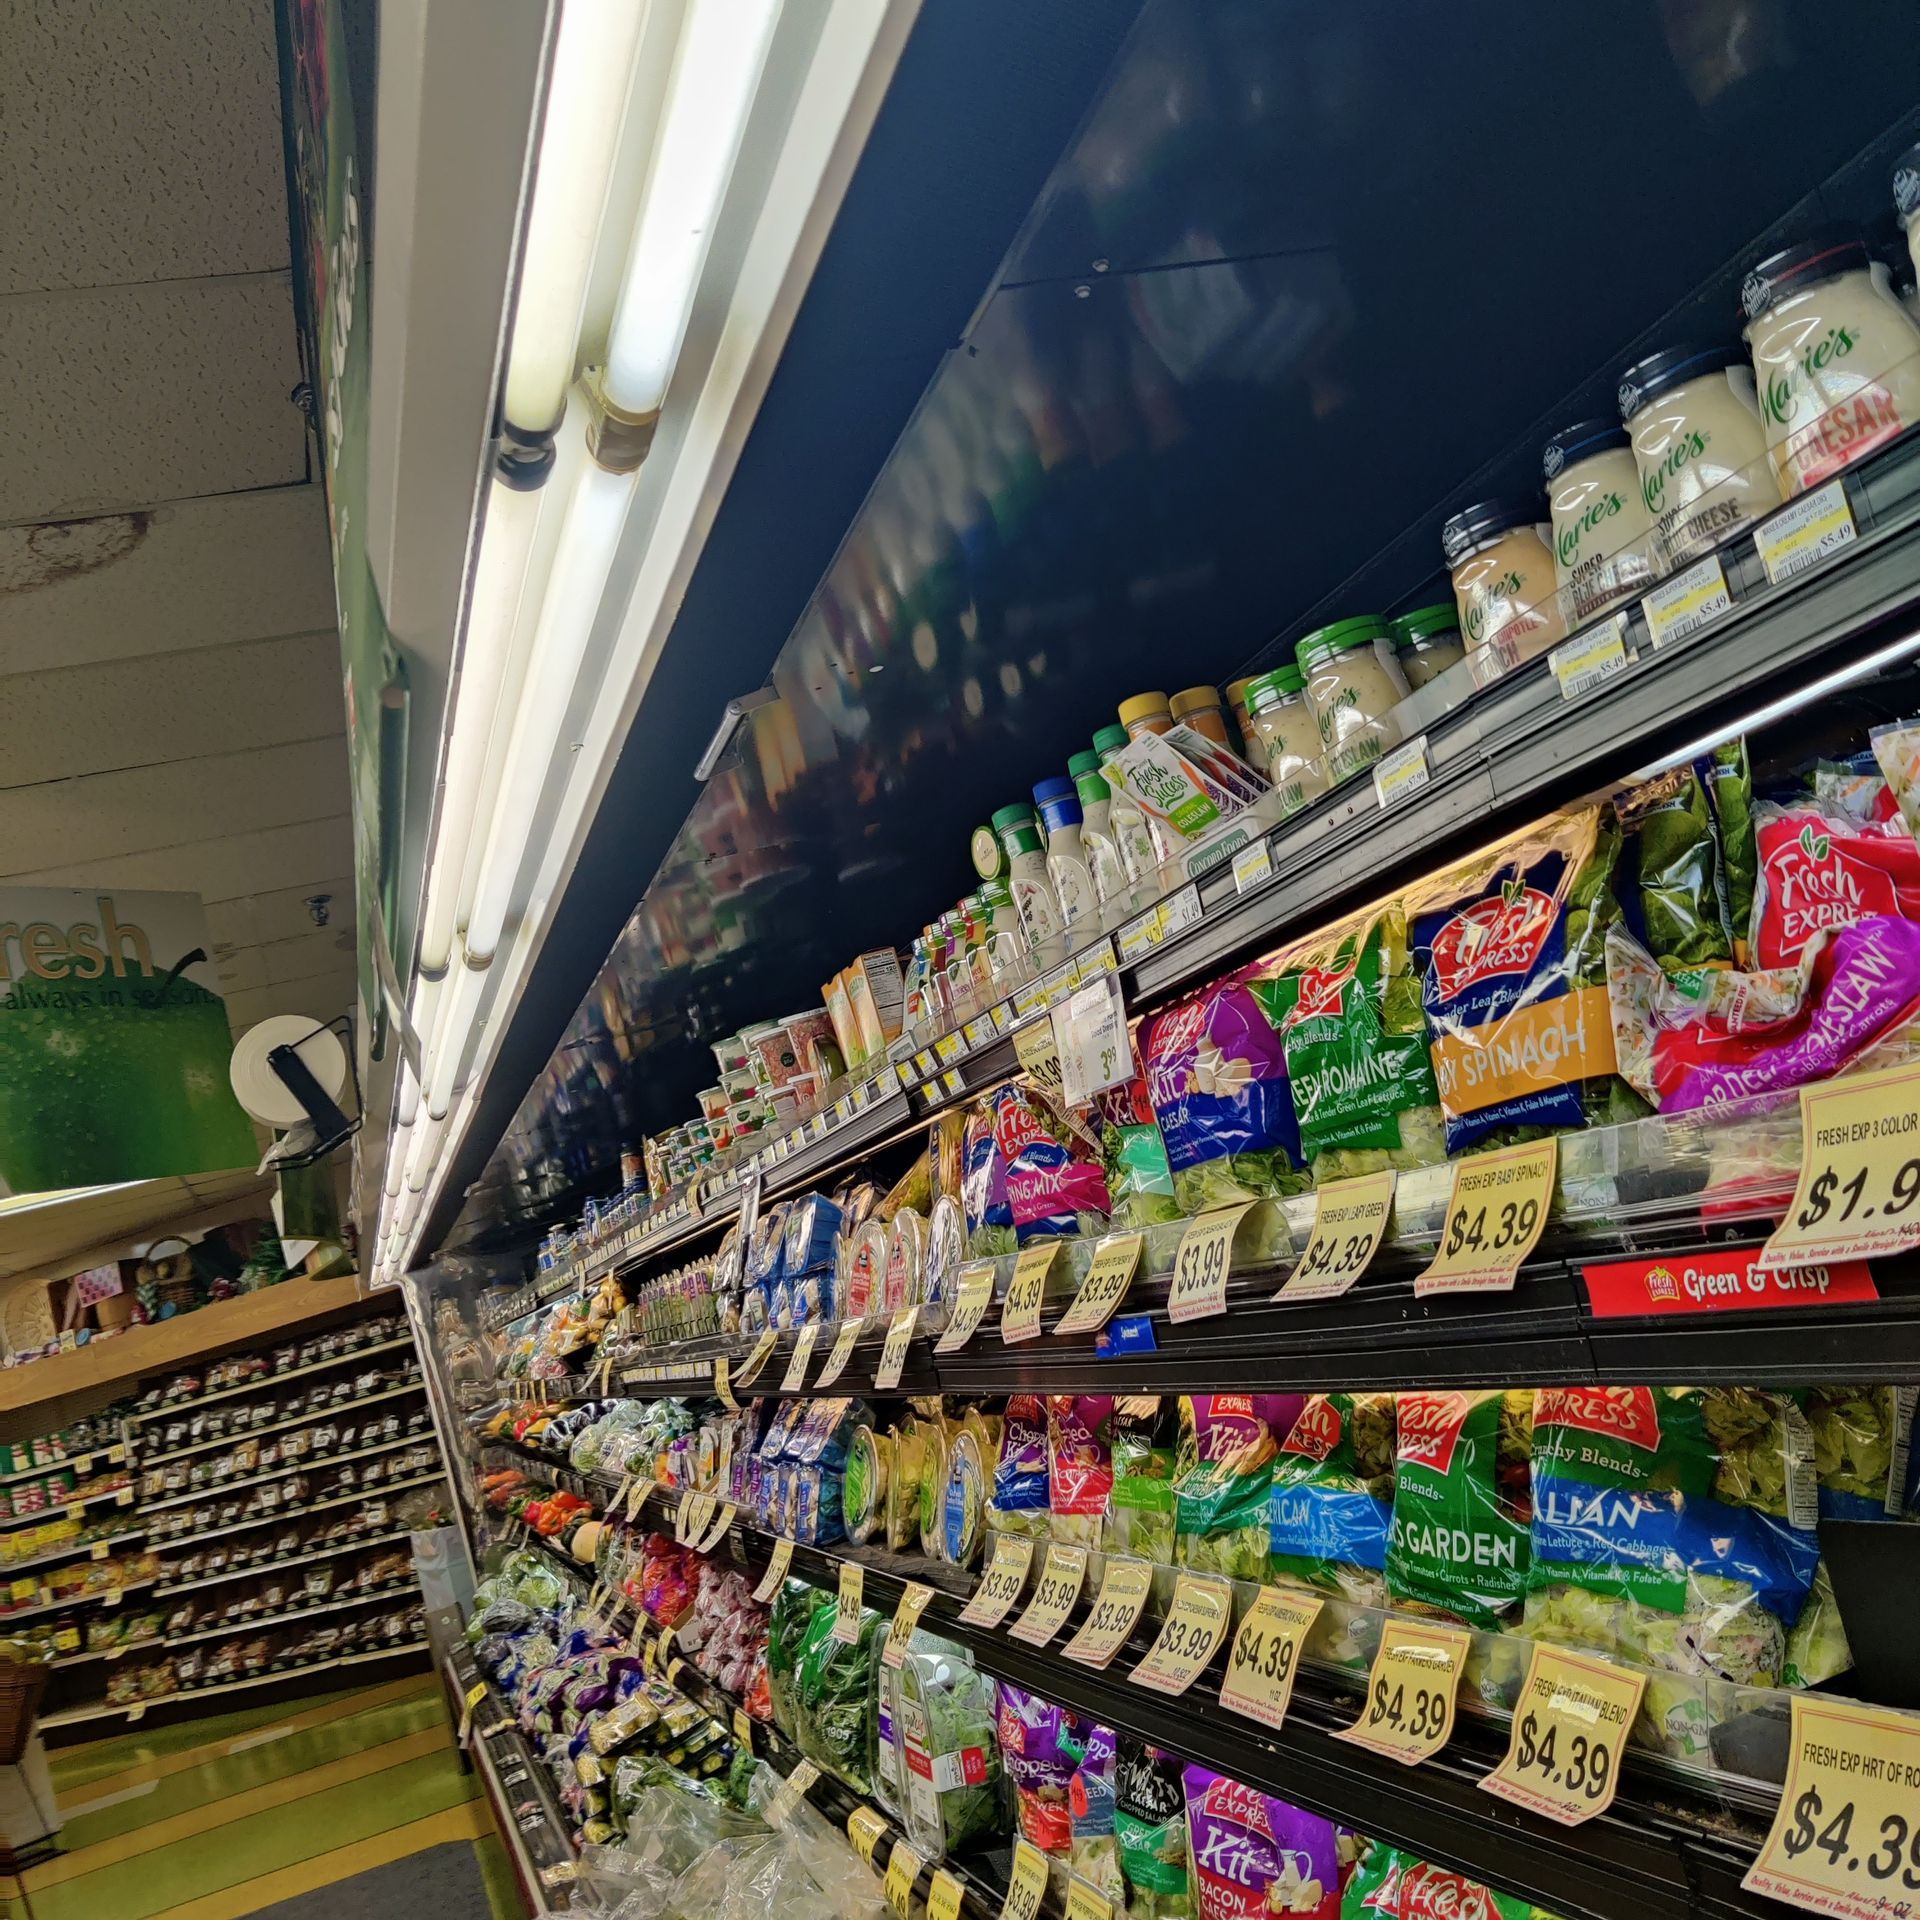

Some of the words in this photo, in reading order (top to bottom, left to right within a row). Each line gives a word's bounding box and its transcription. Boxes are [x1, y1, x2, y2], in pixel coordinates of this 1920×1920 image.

[1757, 325, 1856, 429] Marie's
[1687, 498, 1742, 540] CHEESE
[1820, 524, 1851, 549] $5.49
[1700, 595, 1727, 618] $5.49
[1600, 655, 1624, 676] $5.49
[1127, 759, 1169, 797] Fresh
[1145, 774, 1188, 810] Success
[1178, 804, 1213, 829] COLESLAW
[1774, 852, 1864, 910] Fresh
[0, 896, 155, 980] resh
[1783, 901, 1877, 940] EXPRE
[1453, 942, 1534, 988] EXPRESS
[4, 982, 92, 1011] always
[100, 983, 125, 1008] in
[1471, 993, 1498, 1011] Leaf
[1848, 997, 1898, 1038] Carrots
[1462, 1016, 1586, 1088] SPINACH
[1321, 1049, 1400, 1099] ROMAINE
[998, 1103, 1037, 1140] Fre
[1160, 1106, 1190, 1133] CAESAR
[1337, 1099, 1356, 1114] Green
[1357, 1094, 1372, 1109] Leaf
[1817, 1125, 1850, 1148] FRESH
[1851, 1122, 1871, 1144] EXP
[1872, 1121, 1879, 1138] 3
[1880, 1113, 1919, 1137] COLOR
[1033, 1174, 1061, 1199] MIX
[1459, 1173, 1482, 1193] FRESH
[1482, 1172, 1497, 1188] EXP
[1496, 1167, 1517, 1186] BABY
[1516, 1160, 1548, 1182] SPINACH
[1798, 1158, 1920, 1231] $1.9
[1320, 1206, 1337, 1225] FRESH
[1364, 1201, 1384, 1218] GREEN
[1446, 1198, 1539, 1259] $4.39
[1177, 1237, 1226, 1298] $3.99
[1300, 1234, 1373, 1281] $4.39
[1007, 1277, 1042, 1318] $4.39
[1076, 1273, 1125, 1309] $3.99
[1649, 1271, 1673, 1288] Fresh
[1683, 1268, 1742, 1302] Green
[1746, 1263, 1767, 1292] &
[1773, 1267, 1830, 1295] Crisp
[1398, 1398, 1458, 1432] resh
[1292, 1431, 1334, 1456] RESS
[1398, 1432, 1442, 1457] RESS
[1580, 1447, 1641, 1478] Blends
[1400, 1475, 1441, 1501] Blends
[1269, 1498, 1312, 1528] ERICAN
[1533, 1490, 1643, 1530] ALIAN
[1406, 1522, 1517, 1569] GARDEN
[1547, 1534, 1583, 1548] Lettuce
[981, 1570, 1020, 1601] $3.99
[1035, 1574, 1076, 1611] $3.99
[1440, 1569, 1470, 1585] Carrots
[1477, 1574, 1517, 1591] Radishes
[1546, 1565, 1571, 1578] Vitamin
[1582, 1568, 1612, 1581] Vitamin
[1623, 1571, 1631, 1582] &
[1633, 1571, 1662, 1585] Folate
[1090, 1600, 1136, 1633] $3.99
[1450, 1598, 1473, 1613] Vitamin
[1474, 1605, 1482, 1613] A
[1157, 1617, 1213, 1661] $3.99
[1235, 1623, 1294, 1682] $4.39
[1369, 1673, 1447, 1740] $4.39
[1534, 1677, 1557, 1699] FRESH
[1600, 1702, 1627, 1725] BLEND
[1516, 1709, 1610, 1799] $4.39
[1803, 1742, 1837, 1769] FRESH
[1840, 1751, 1861, 1773] EXP
[1863, 1756, 1886, 1780] HRT
[1887, 1761, 1905, 1784] OF
[1198, 1824, 1252, 1886] Kit
[1007, 1878, 1036, 1917] $3.99
[1199, 1876, 1246, 1911] BACON
[1793, 1888, 1814, 1903] Service
[1833, 1902, 1852, 1915] Smile
